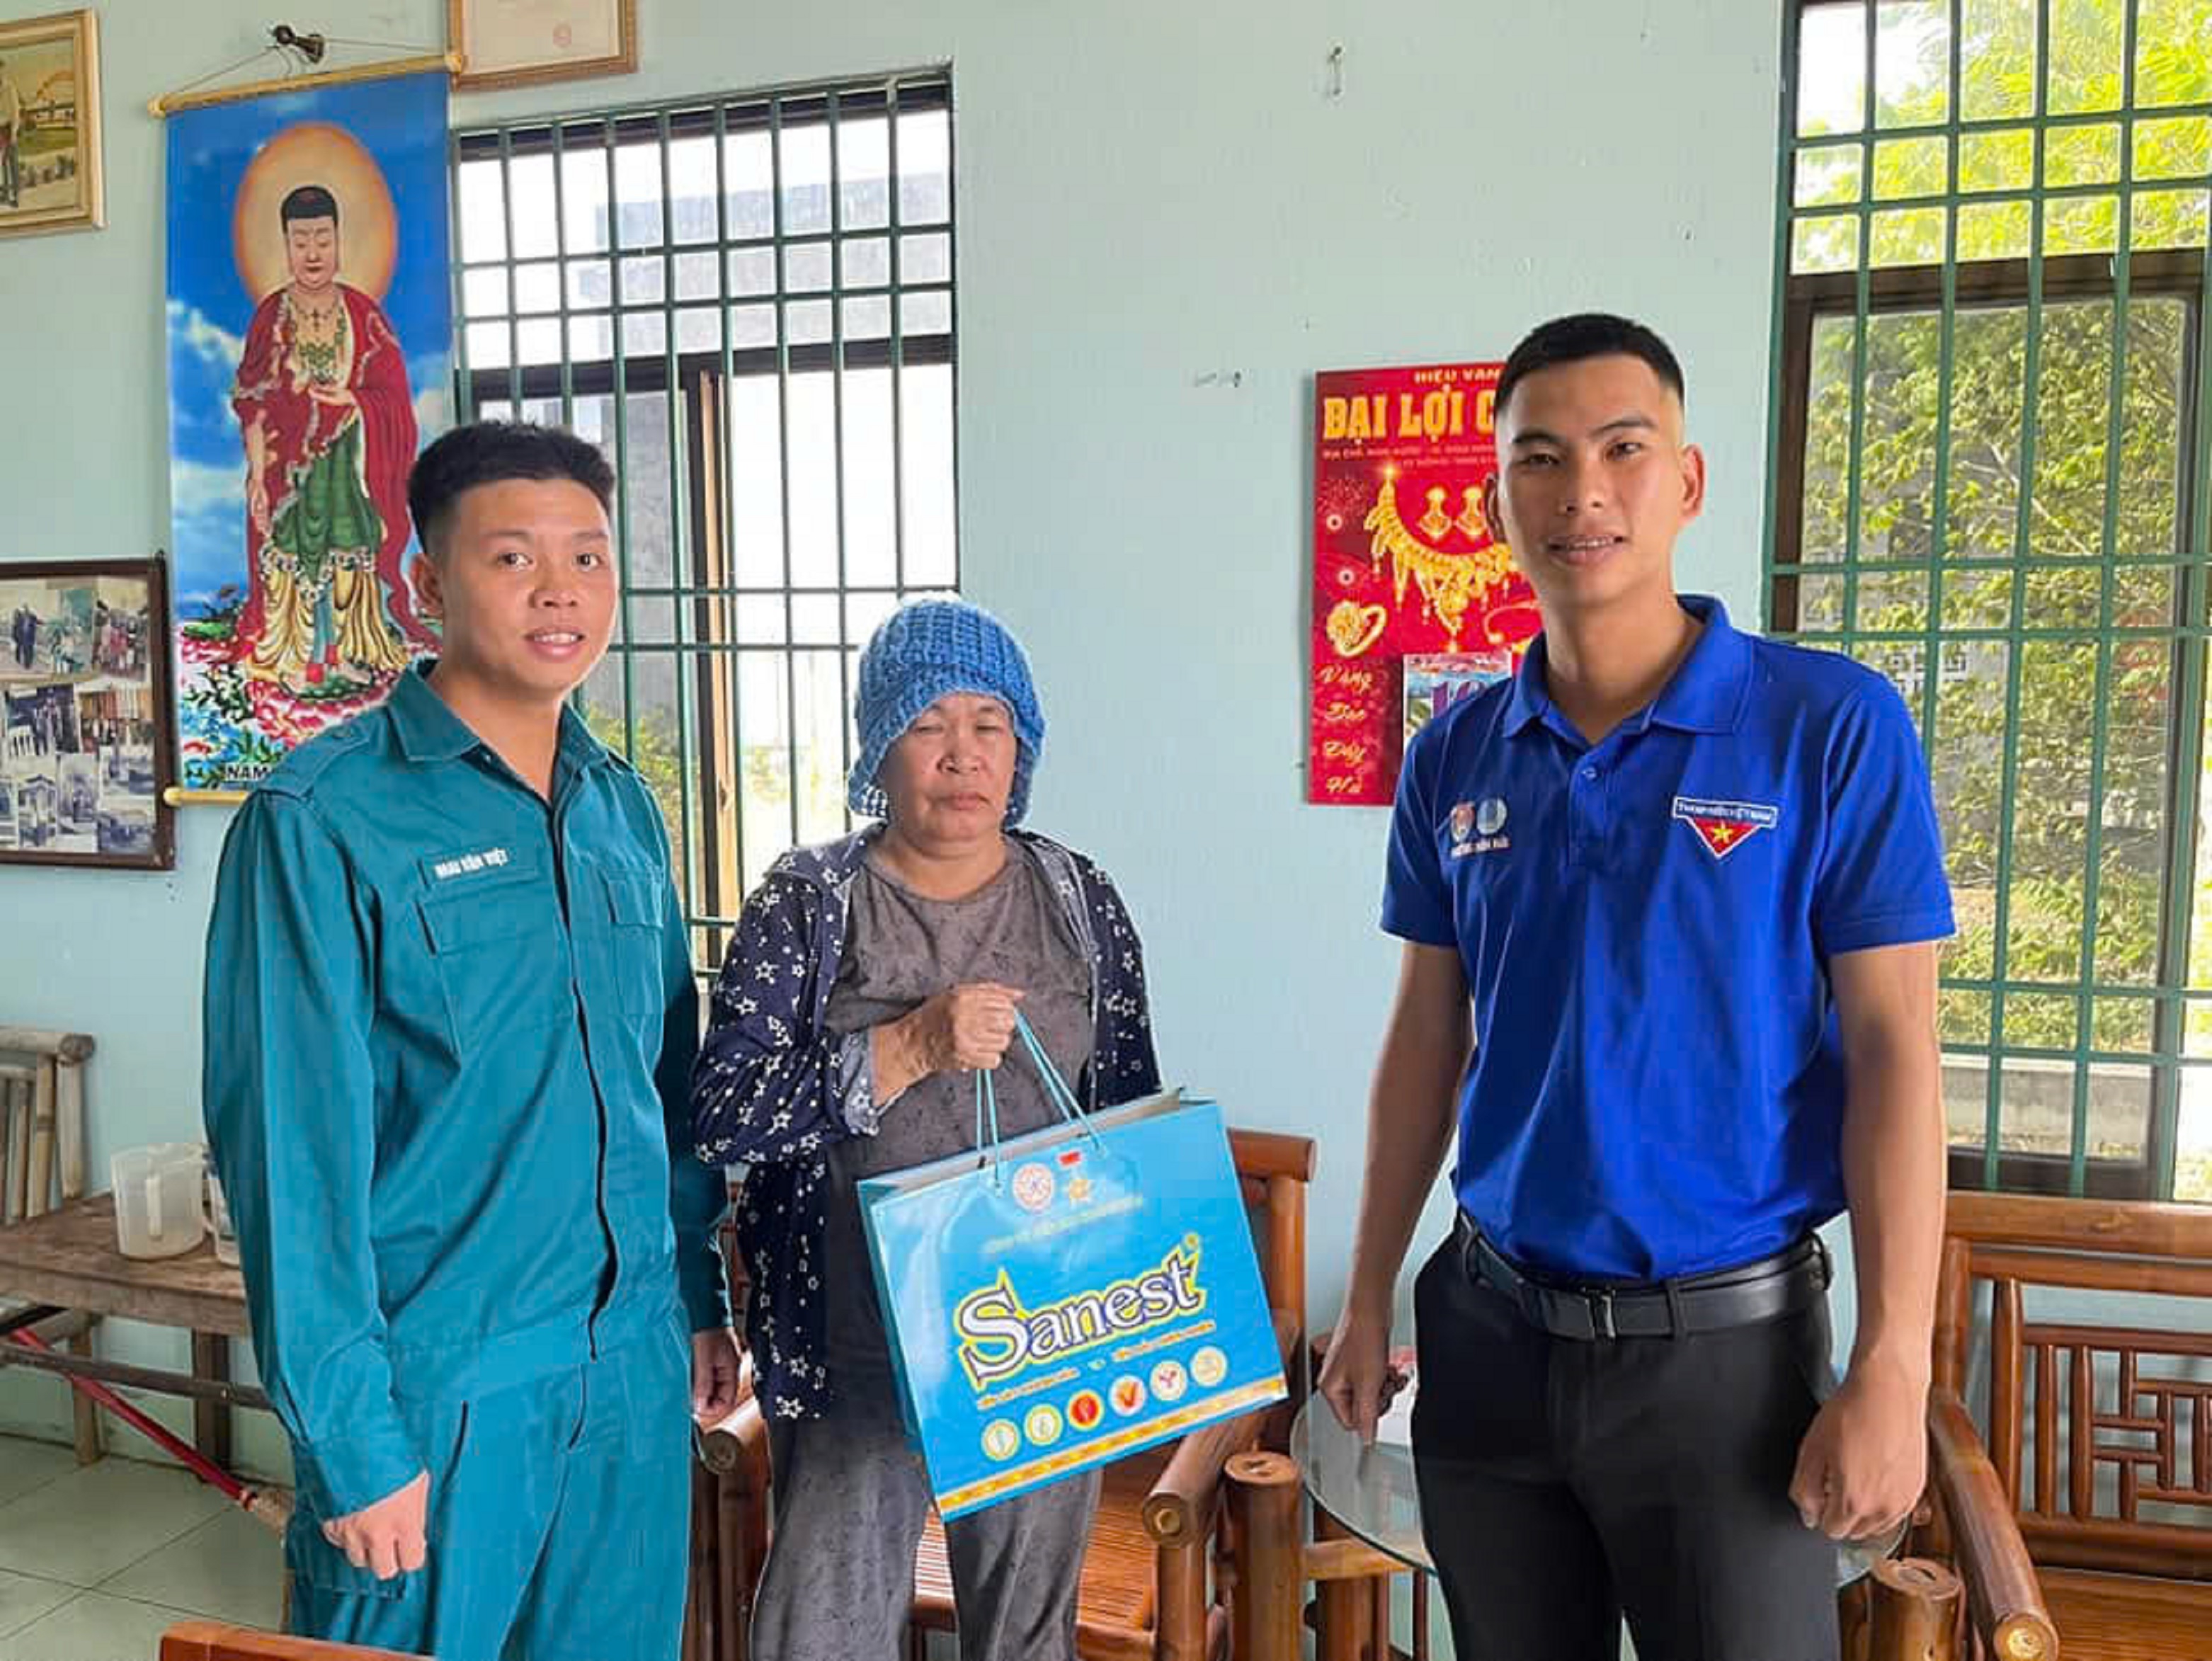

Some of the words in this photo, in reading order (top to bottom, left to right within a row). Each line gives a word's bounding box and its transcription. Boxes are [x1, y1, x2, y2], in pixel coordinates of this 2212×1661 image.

[1323, 394, 1387, 446] ĐẠI
[1398, 384, 1464, 443] LỢI
[955, 1250, 1205, 1391] Sanest
